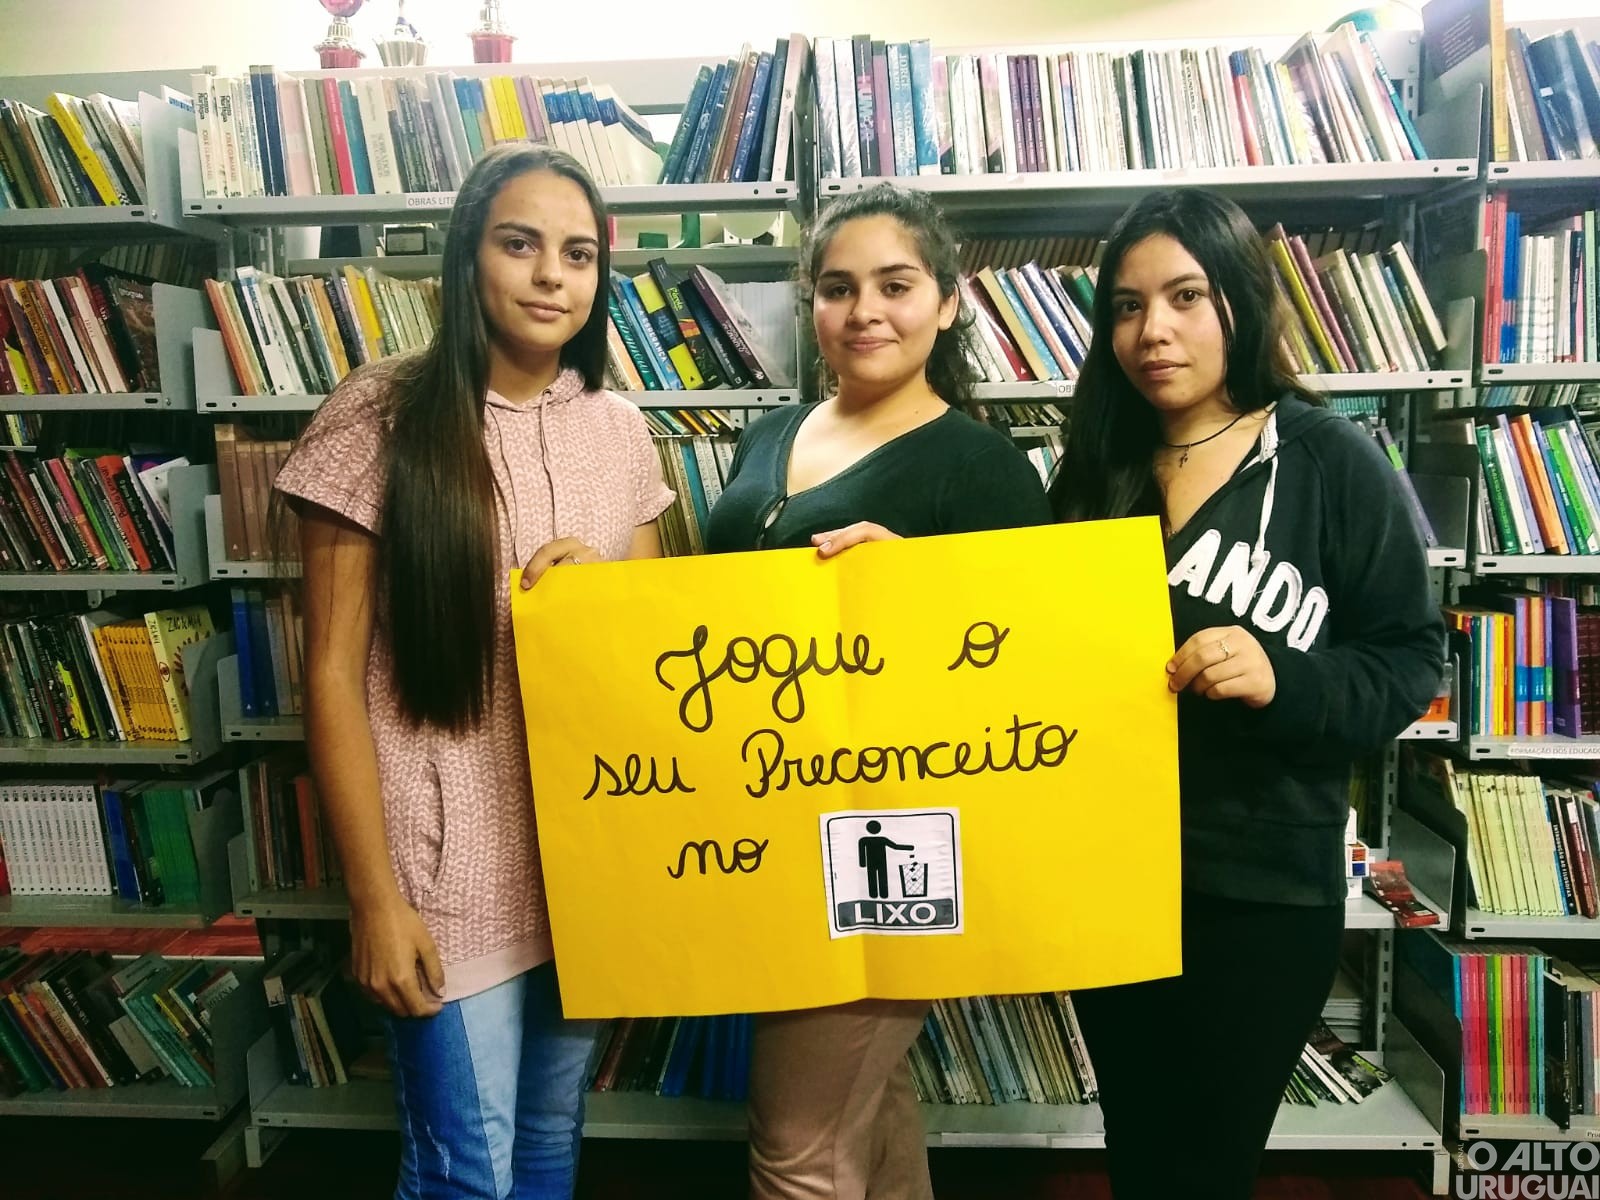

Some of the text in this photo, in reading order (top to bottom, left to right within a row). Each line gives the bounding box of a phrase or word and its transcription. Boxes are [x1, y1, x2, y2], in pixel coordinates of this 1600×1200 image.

[407, 197, 437, 206] OBRAS
[656, 622, 1009, 732] Jogue o
[583, 714, 1077, 800] seu Preconceito
[668, 838, 768, 879] no
[854, 902, 937, 924] LIXO
